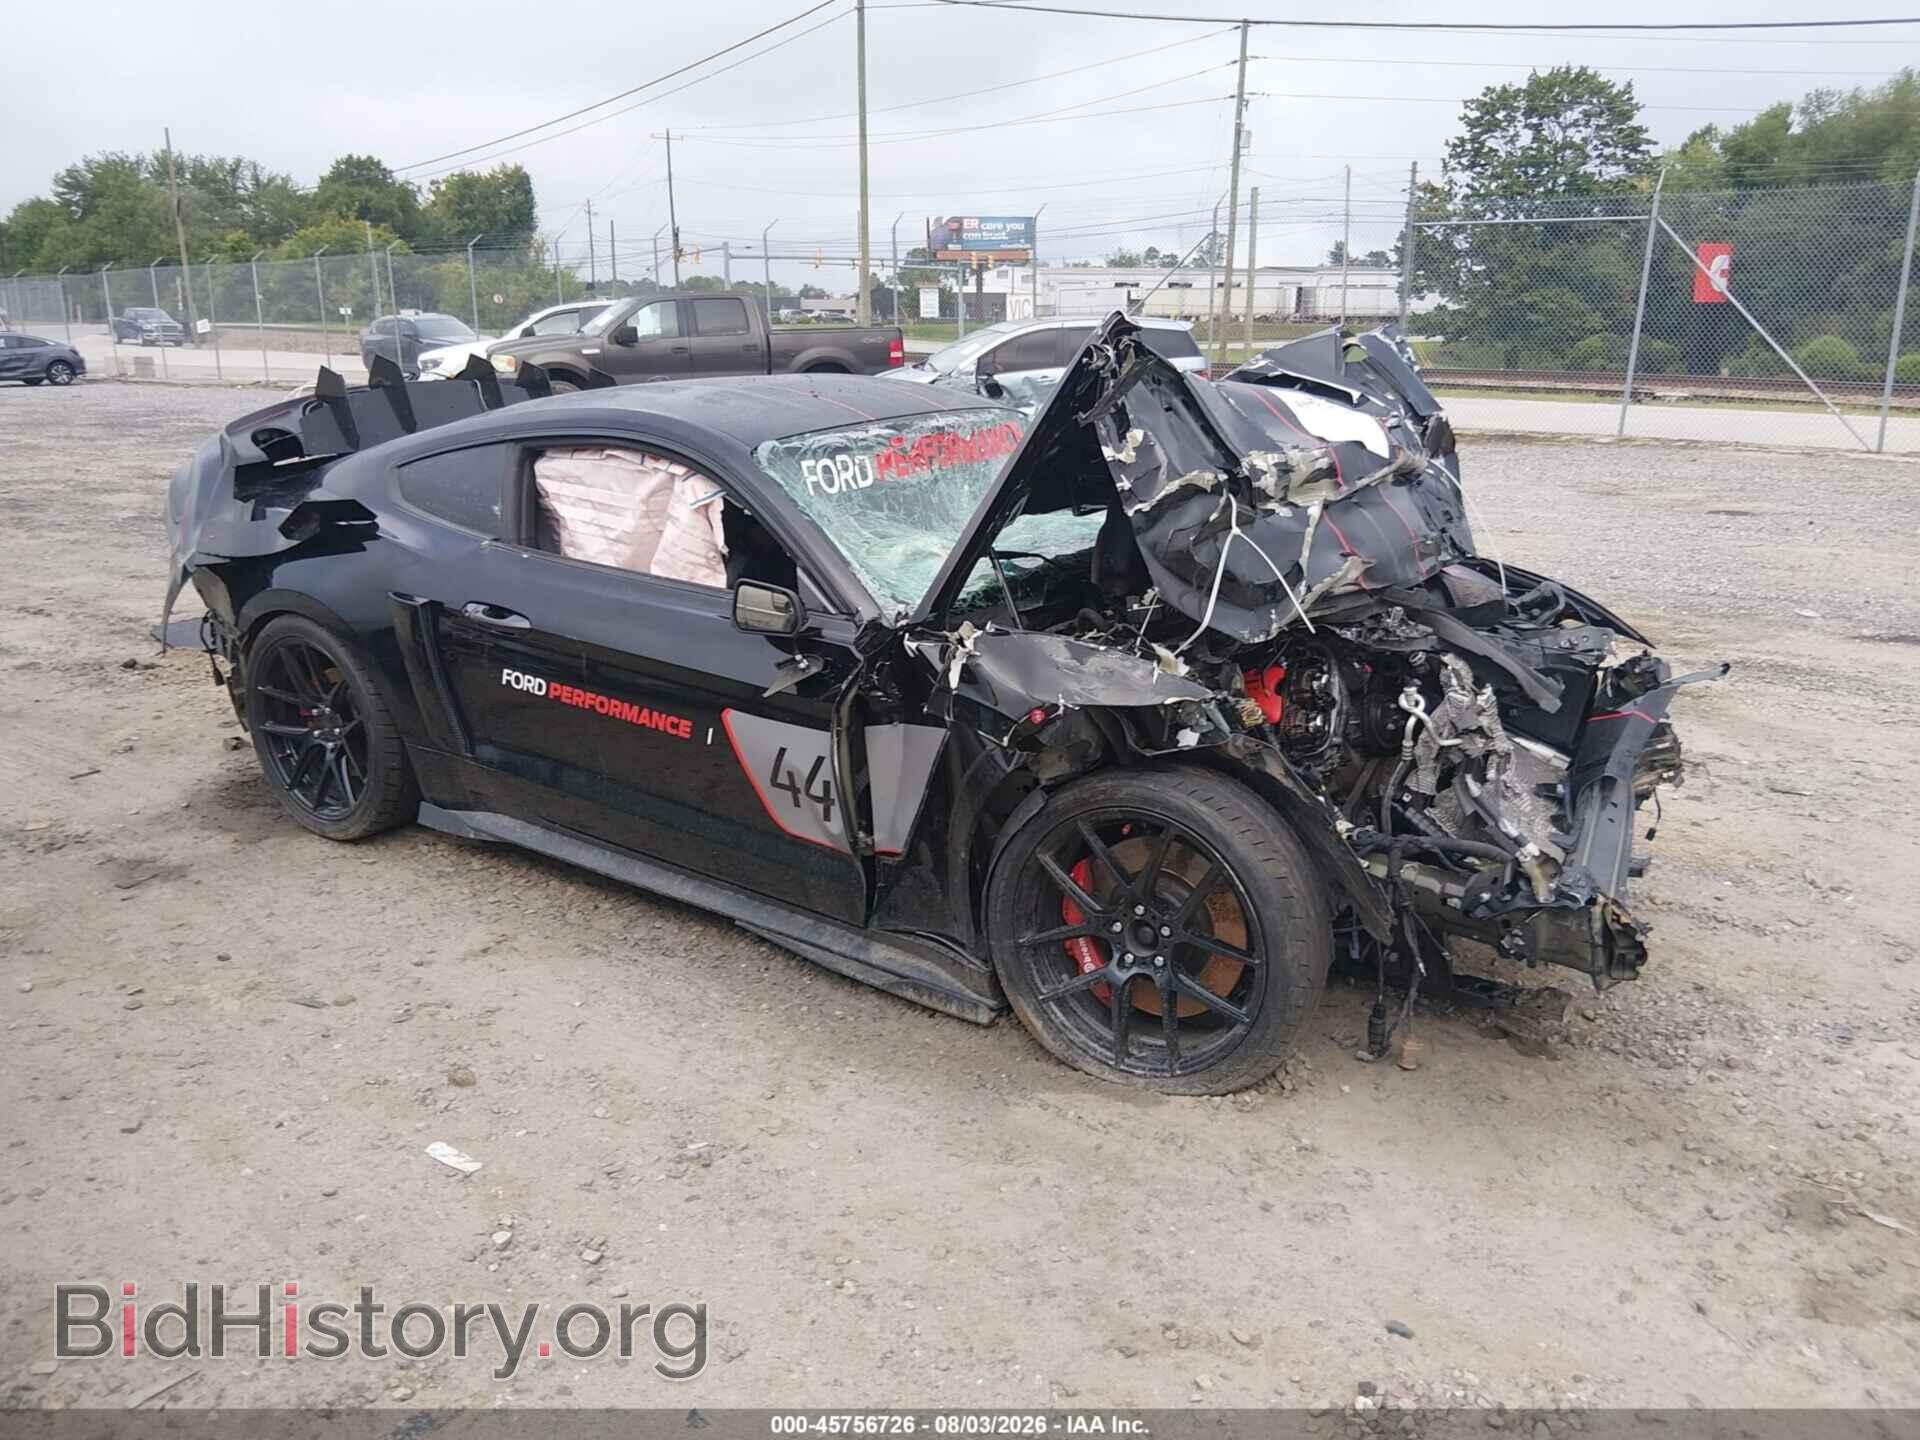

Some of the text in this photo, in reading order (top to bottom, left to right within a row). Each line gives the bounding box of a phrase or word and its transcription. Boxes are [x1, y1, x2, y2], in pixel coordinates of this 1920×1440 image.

[962, 232, 981, 240] can
[963, 218, 1025, 232] ER care you
[800, 454, 874, 496] FORD
[501, 668, 694, 739] FORD PERFORMANCE
[769, 746, 836, 823] 44
